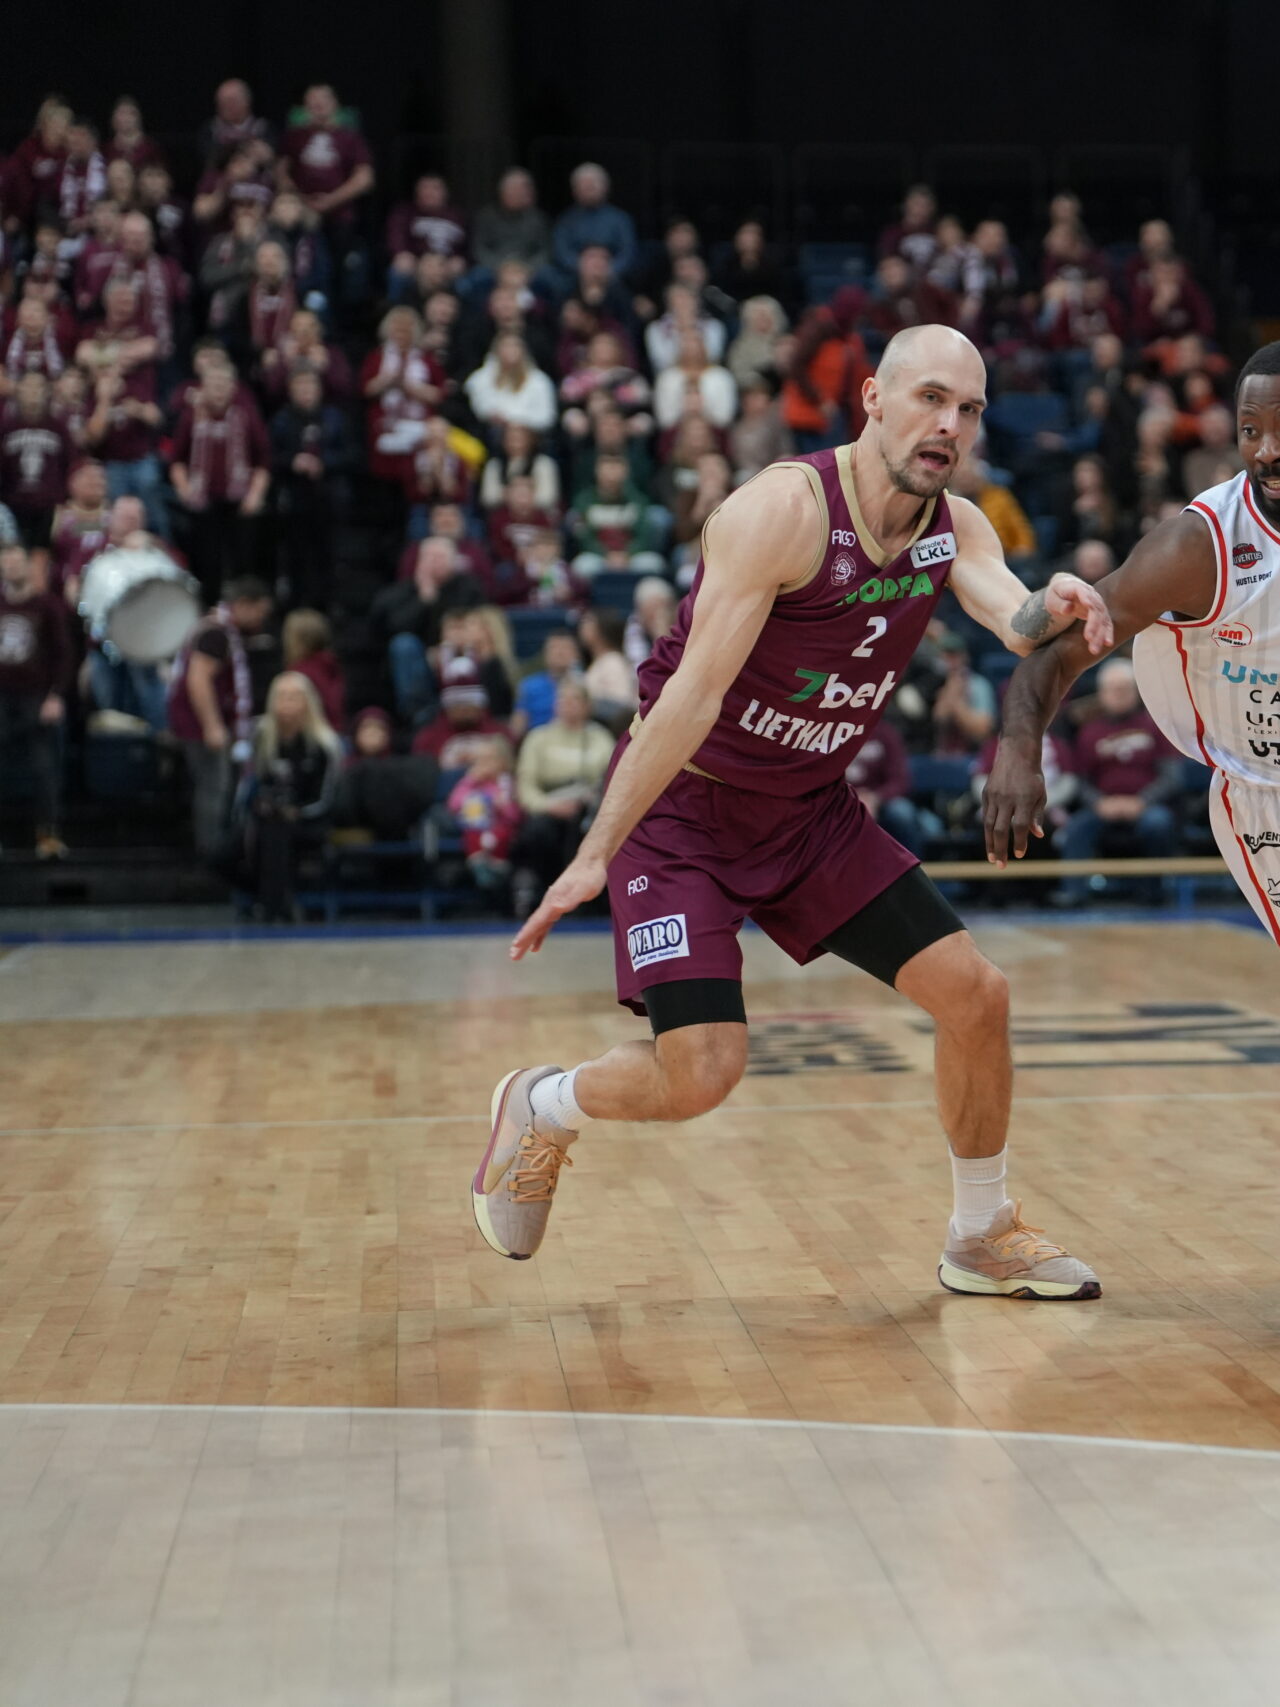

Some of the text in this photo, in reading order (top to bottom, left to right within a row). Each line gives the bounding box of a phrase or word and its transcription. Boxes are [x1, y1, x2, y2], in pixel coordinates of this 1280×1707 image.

[915, 540, 942, 552] betsafe
[917, 546, 951, 562] LKL
[851, 616, 887, 657] 2
[784, 668, 896, 710] 7bet
